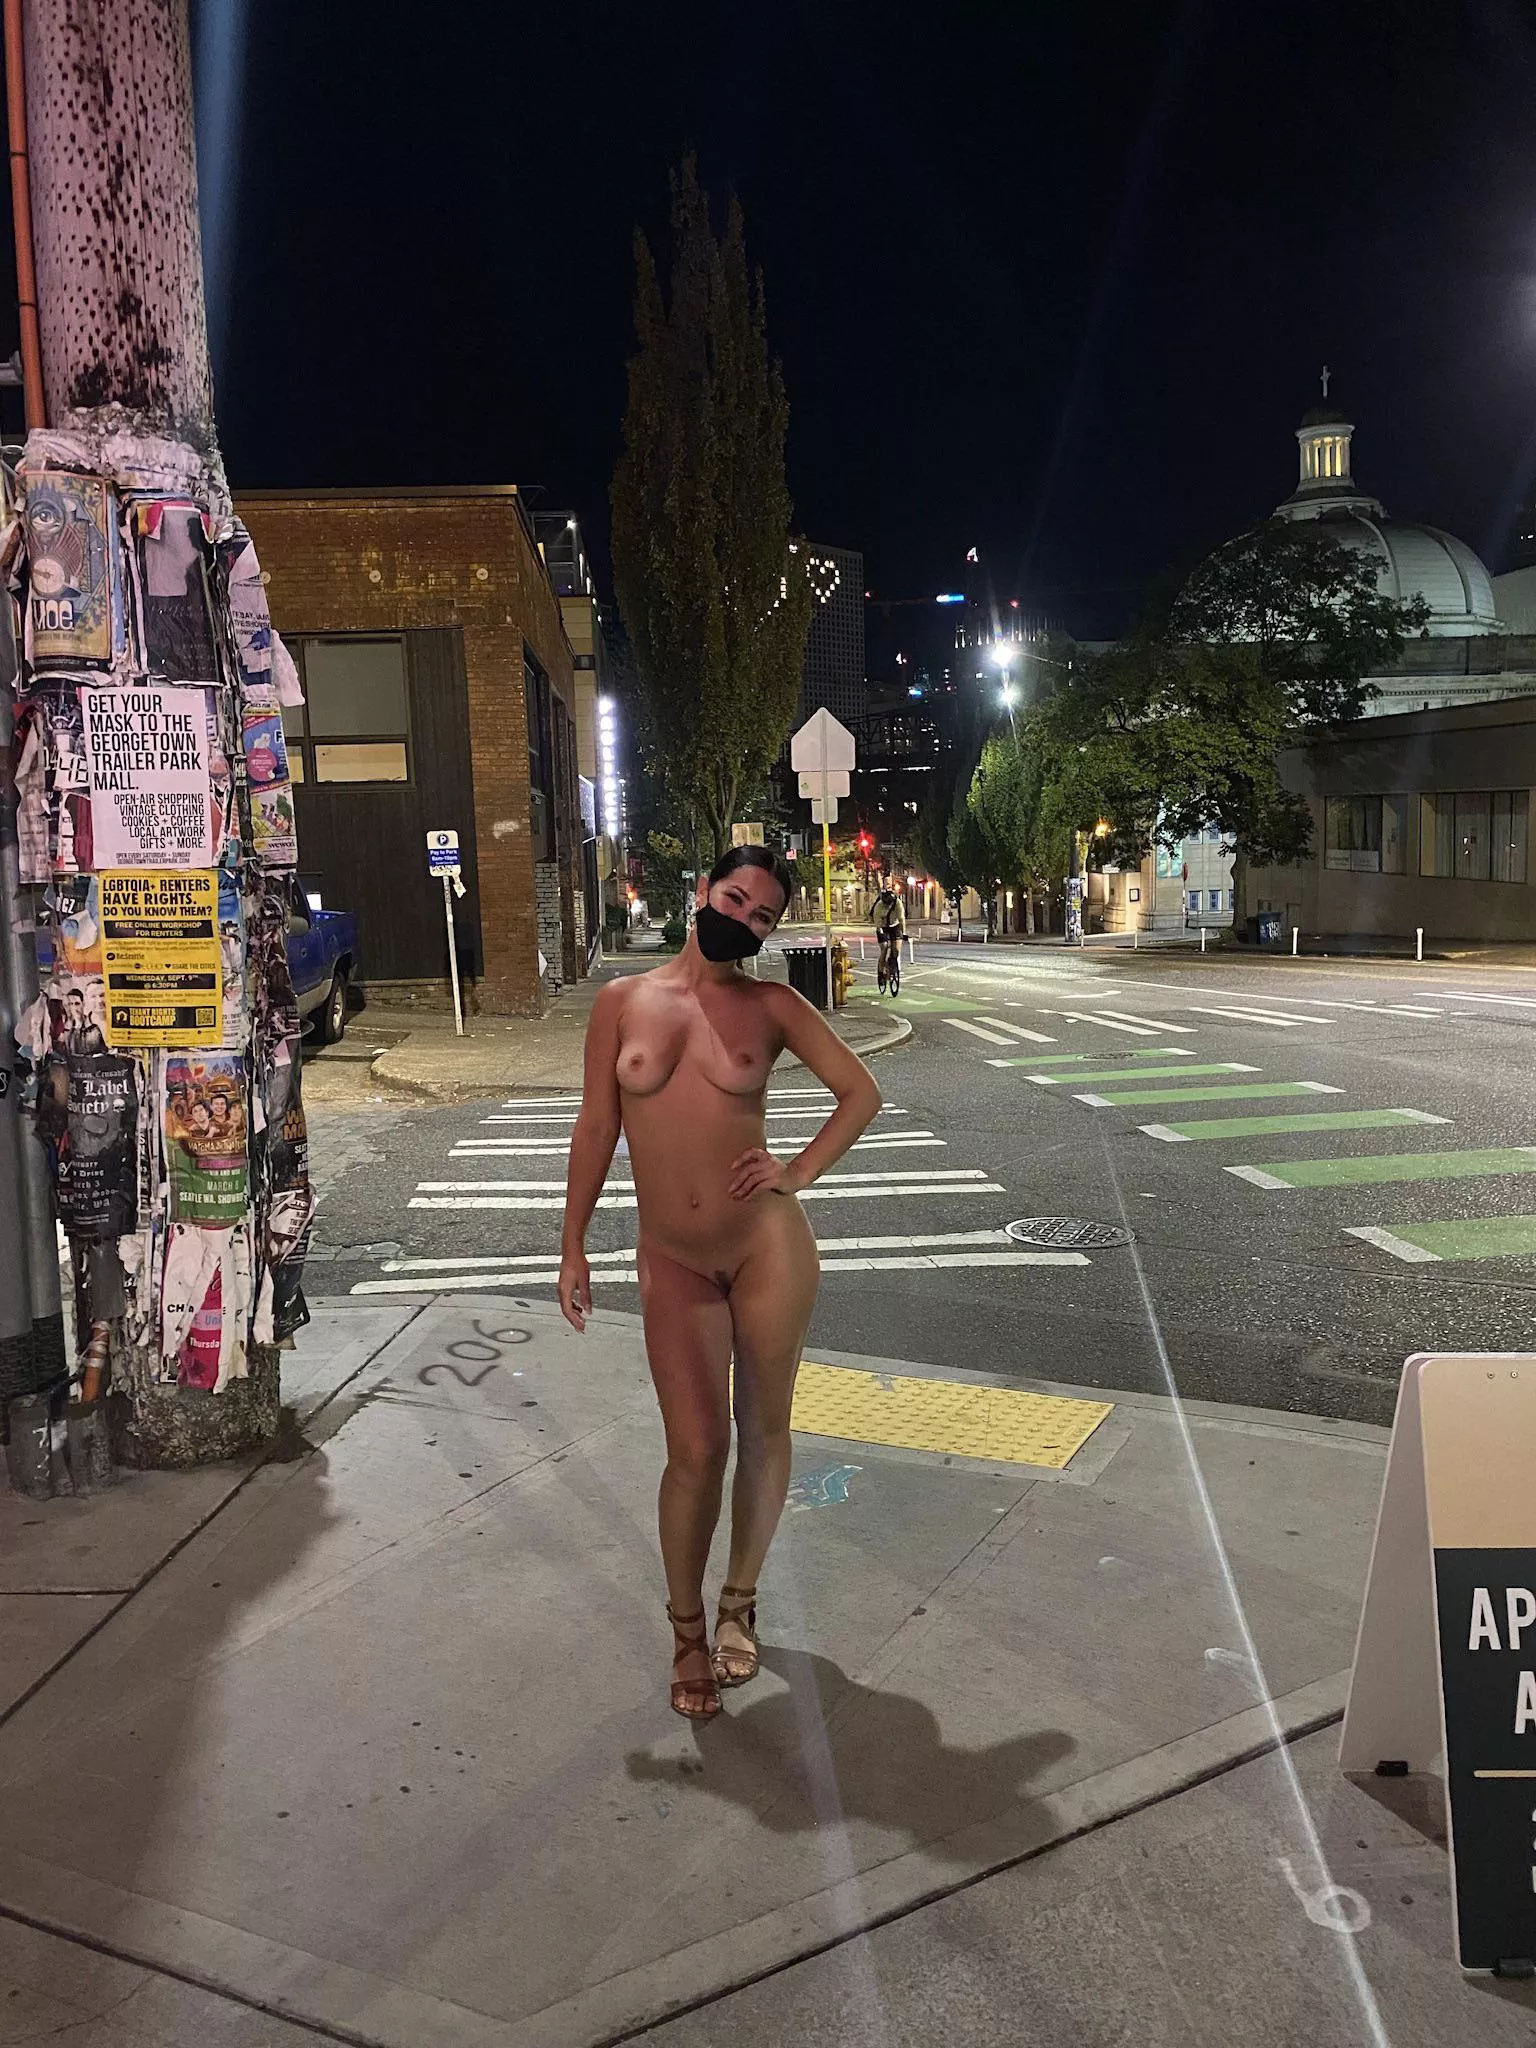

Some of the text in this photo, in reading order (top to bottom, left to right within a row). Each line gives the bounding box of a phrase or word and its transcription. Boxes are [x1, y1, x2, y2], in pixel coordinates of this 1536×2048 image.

[88, 694, 163, 713] GET YOUR
[89, 714, 193, 733] MASK TO THE
[91, 732, 197, 752] GEORGETOWN
[92, 752, 202, 771] TRAILER PARK
[94, 772, 139, 791] MALL.
[114, 793, 204, 805] OPEN-AIR SHOPPING
[119, 804, 204, 816] VINTAGE CLOTHING
[122, 816, 160, 827] COOKIES
[170, 816, 205, 826] COFFEE
[129, 827, 206, 838] LOCAL ARTWORK
[140, 838, 166, 849] GIFTS
[176, 838, 206, 849] MORE.
[103, 879, 210, 892] LGBTQIA+ RENTERS
[103, 892, 197, 905] HAVE RIGHTS.
[103, 906, 213, 916] DO YOU KNOW THEM?
[161, 921, 202, 929] WORKSHOP
[151, 1008, 176, 1017] RIGHTS
[129, 1016, 177, 1026] BOOTCAMP
[82, 1079, 130, 1097] Label
[207, 1181, 233, 1191] MARCH
[190, 1337, 220, 1348] Thursda
[417, 1319, 533, 1387] 206
